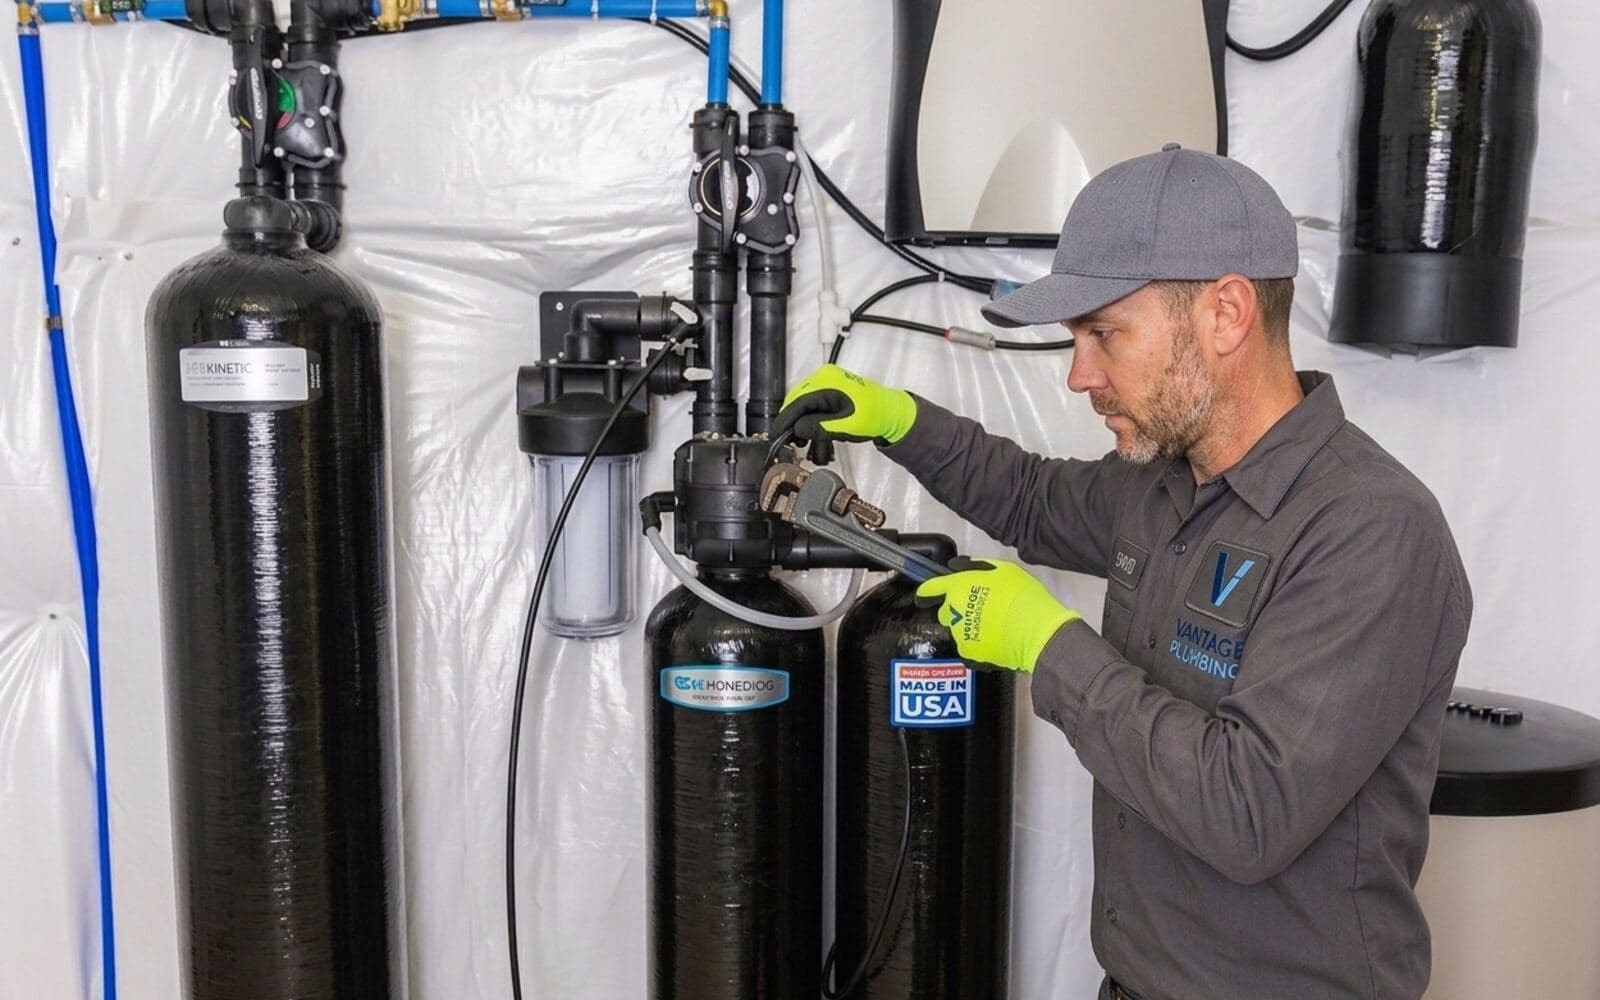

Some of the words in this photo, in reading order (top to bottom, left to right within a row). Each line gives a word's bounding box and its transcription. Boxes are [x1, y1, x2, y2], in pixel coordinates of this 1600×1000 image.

[1177, 617, 1245, 660] VANTAGE
[900, 680, 947, 691] MADE
[951, 680, 967, 691] IN
[902, 695, 965, 718] USA
